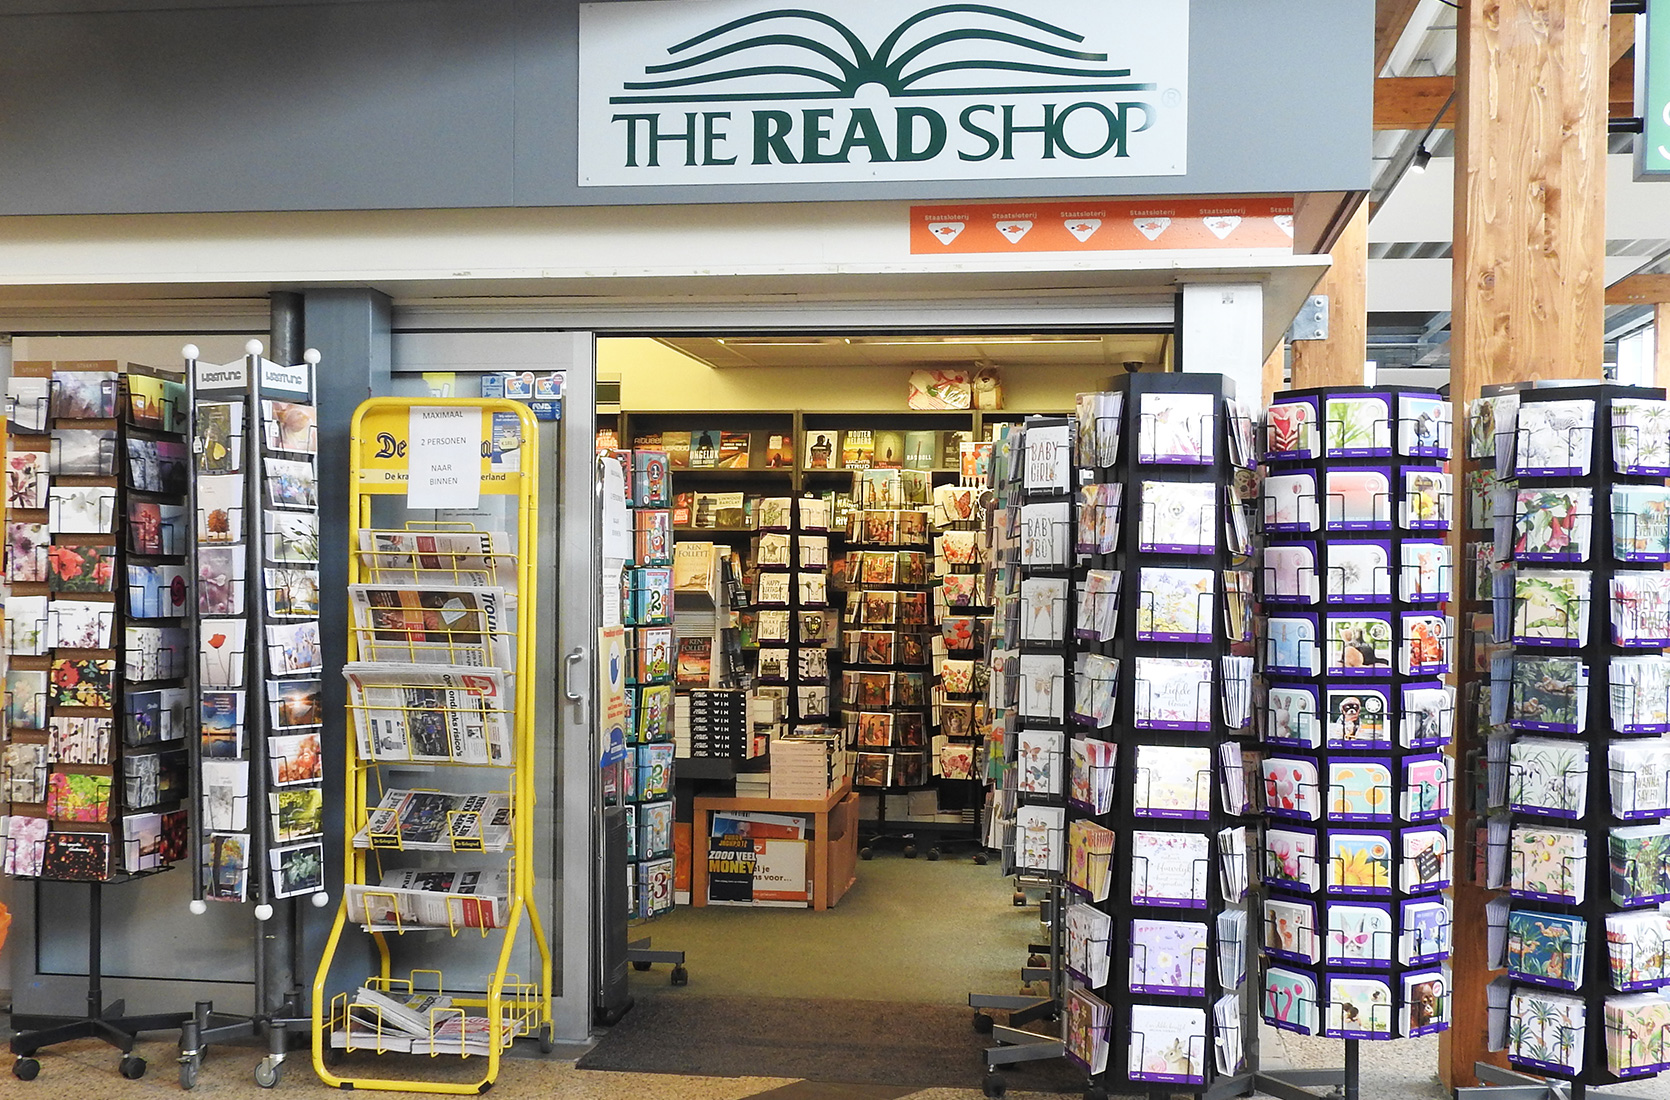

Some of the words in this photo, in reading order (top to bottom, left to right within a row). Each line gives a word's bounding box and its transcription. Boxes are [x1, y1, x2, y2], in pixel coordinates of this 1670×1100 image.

[610, 111, 738, 168] THE
[750, 106, 948, 165] READ
[957, 101, 1157, 162] SHOP
[1060, 210, 1106, 218] Staatsloterij
[1199, 207, 1246, 215] Staatsloterij
[992, 212, 1037, 220] Staatsloterij
[422, 411, 464, 419] MAXIMAAL
[375, 432, 407, 458] De
[427, 437, 467, 446] PERSONEN
[1031, 442, 1059, 460] BABY
[431, 464, 452, 472] NAAR
[1030, 464, 1056, 483] GIRL
[429, 478, 458, 486] BINNEN
[1028, 518, 1054, 536] BABY
[1034, 538, 1055, 558] BOY
[678, 550, 709, 558] FOLLETT
[736, 851, 757, 861] VEEL
[709, 860, 756, 874] MONEY
[762, 865, 770, 873] je
